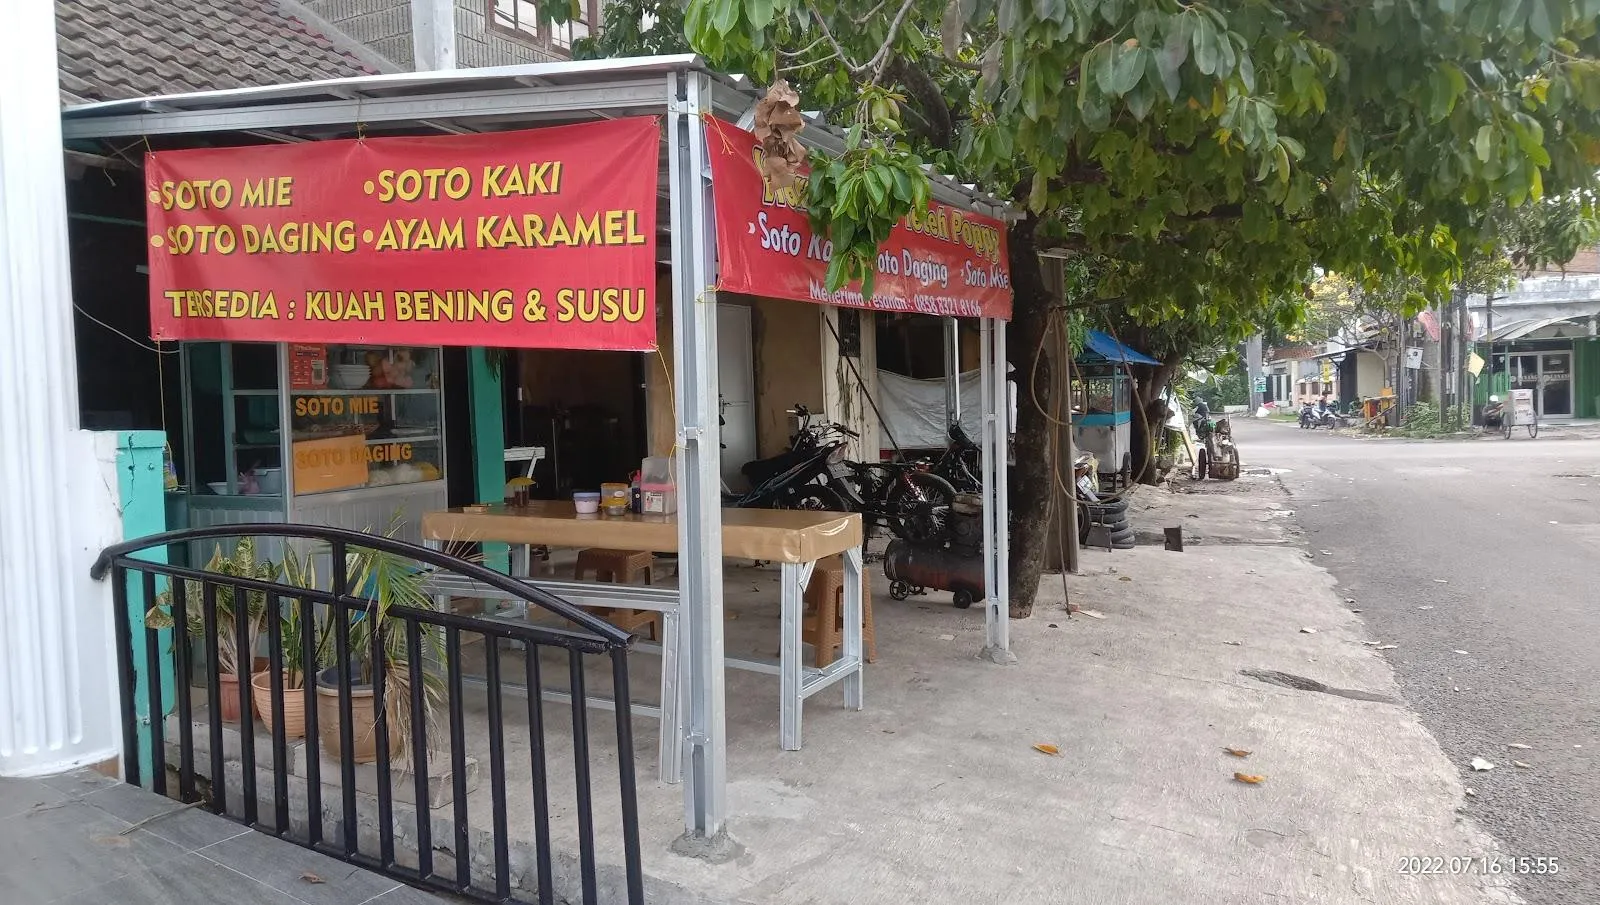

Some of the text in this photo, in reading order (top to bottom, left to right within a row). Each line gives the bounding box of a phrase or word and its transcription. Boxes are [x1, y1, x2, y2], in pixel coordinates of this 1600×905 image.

[162, 176, 294, 211] SOTO MIE
[378, 161, 562, 203] SOTO KAKI
[167, 219, 356, 256] SOTO DAGING
[375, 209, 646, 251] AYAM KARAMEL
[757, 211, 801, 257] Soto
[952, 209, 999, 270] Poppy
[876, 249, 949, 288] oto Daging
[964, 260, 1009, 290] Soto Mie
[164, 289, 280, 320] TERSEDIA
[305, 290, 386, 322] KUAH
[394, 289, 514, 323] BENING
[522, 289, 547, 322] &
[556, 288, 646, 324] SUSU
[295, 397, 380, 417] SOTO MIE
[296, 443, 413, 470] SOTO DAGING
